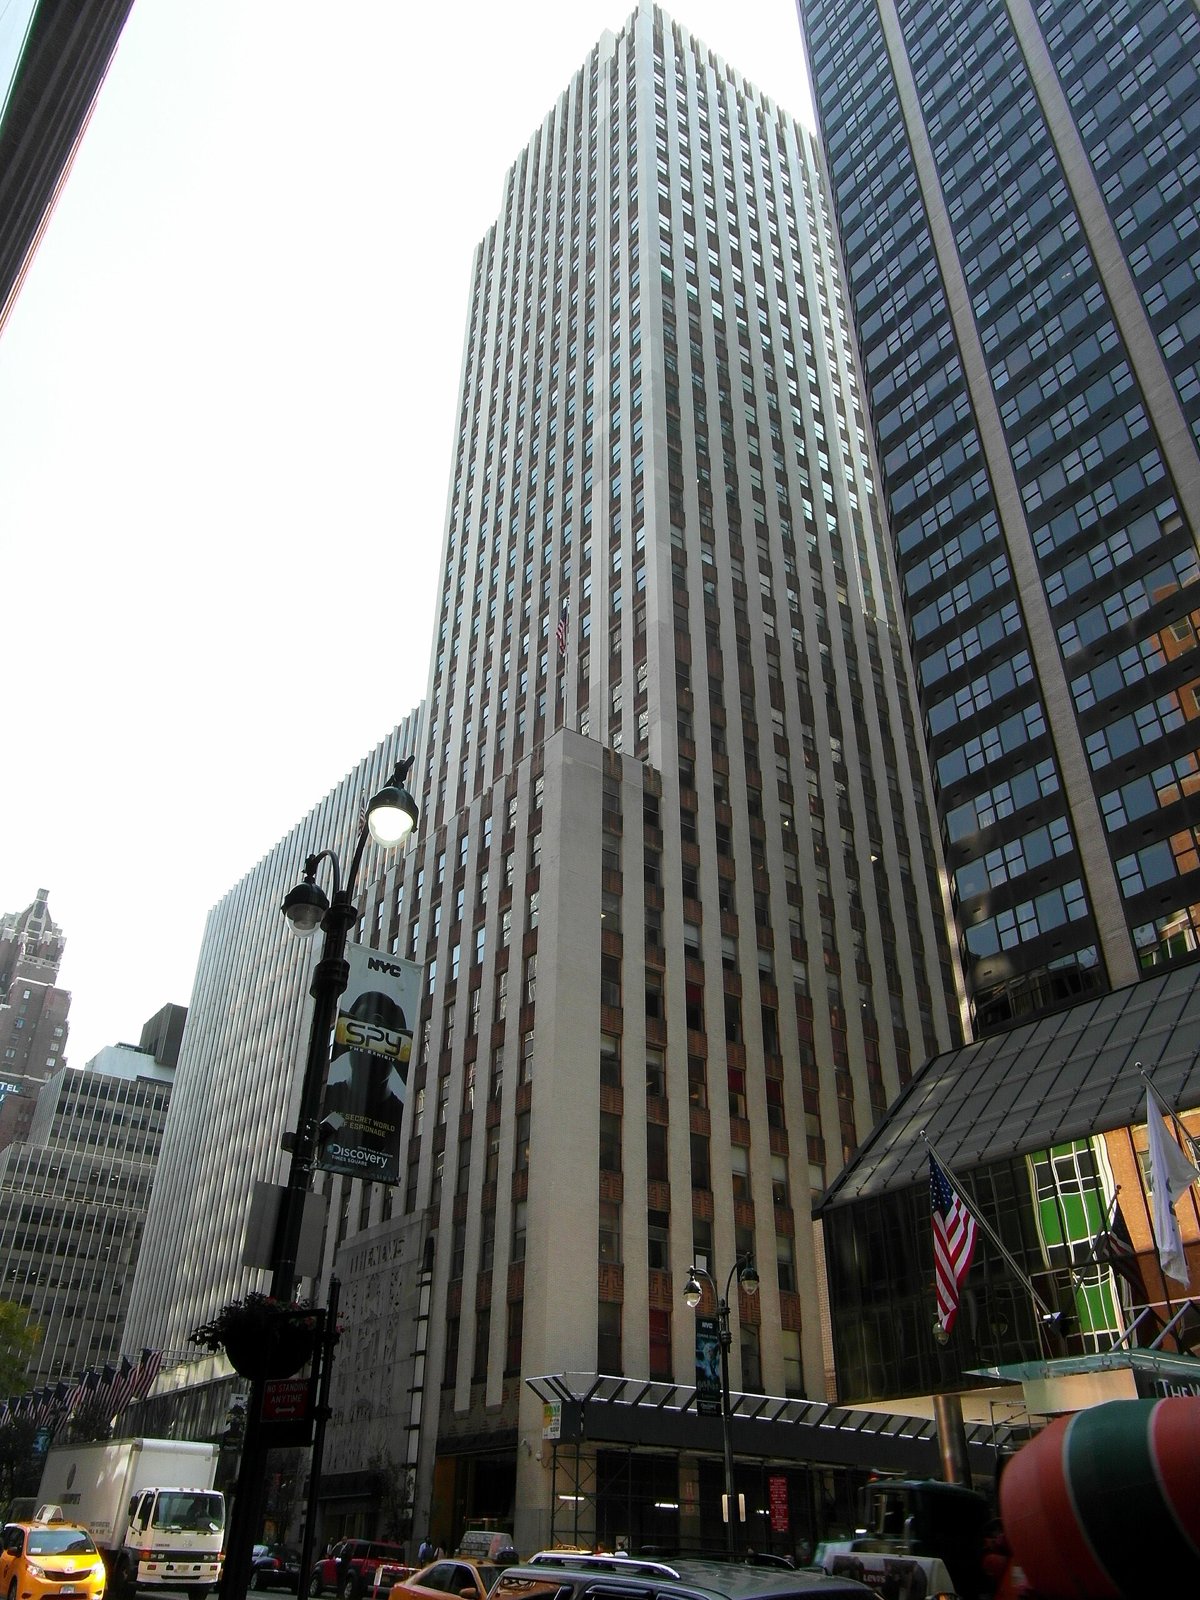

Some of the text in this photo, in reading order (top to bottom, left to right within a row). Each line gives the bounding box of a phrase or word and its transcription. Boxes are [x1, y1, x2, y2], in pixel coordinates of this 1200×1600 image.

[367, 957, 402, 978] NYC
[346, 1022, 402, 1056] SPY
[367, 1049, 395, 1062] EXHIBIT
[345, 1113, 395, 1132] SECRET WORLD
[350, 1122, 386, 1138] ESPIONAGE
[331, 1154, 368, 1167] TIMES SQUARE
[266, 1382, 308, 1393] NO STANDING
[1158, 1379, 1188, 1398] THE
[270, 1393, 303, 1404] ANYTIME
